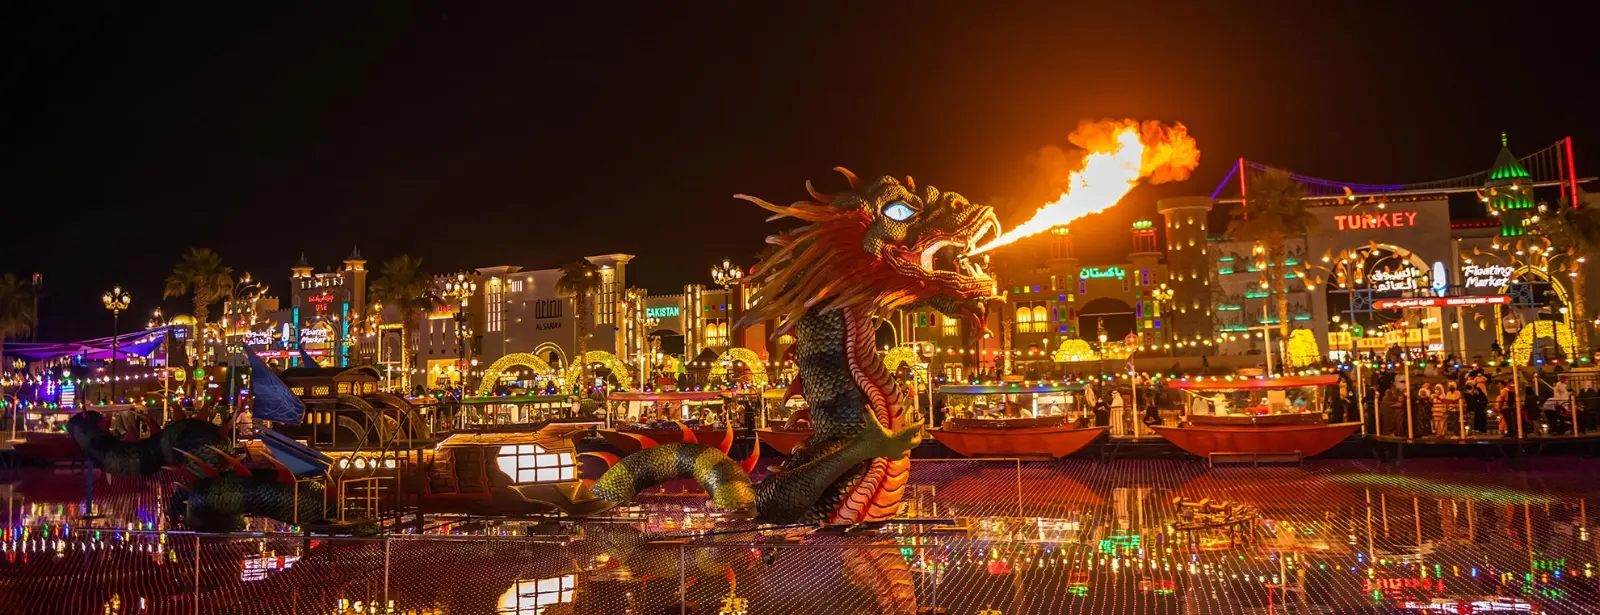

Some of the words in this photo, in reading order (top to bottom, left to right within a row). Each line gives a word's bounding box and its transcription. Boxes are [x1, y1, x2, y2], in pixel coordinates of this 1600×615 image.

[1333, 211, 1418, 231] TURKEY
[1371, 266, 1417, 282] السوق
[1464, 265, 1514, 278] Floating
[1465, 276, 1509, 288] Market
[315, 303, 328, 312] UAE
[646, 306, 680, 318] PAKISTAN
